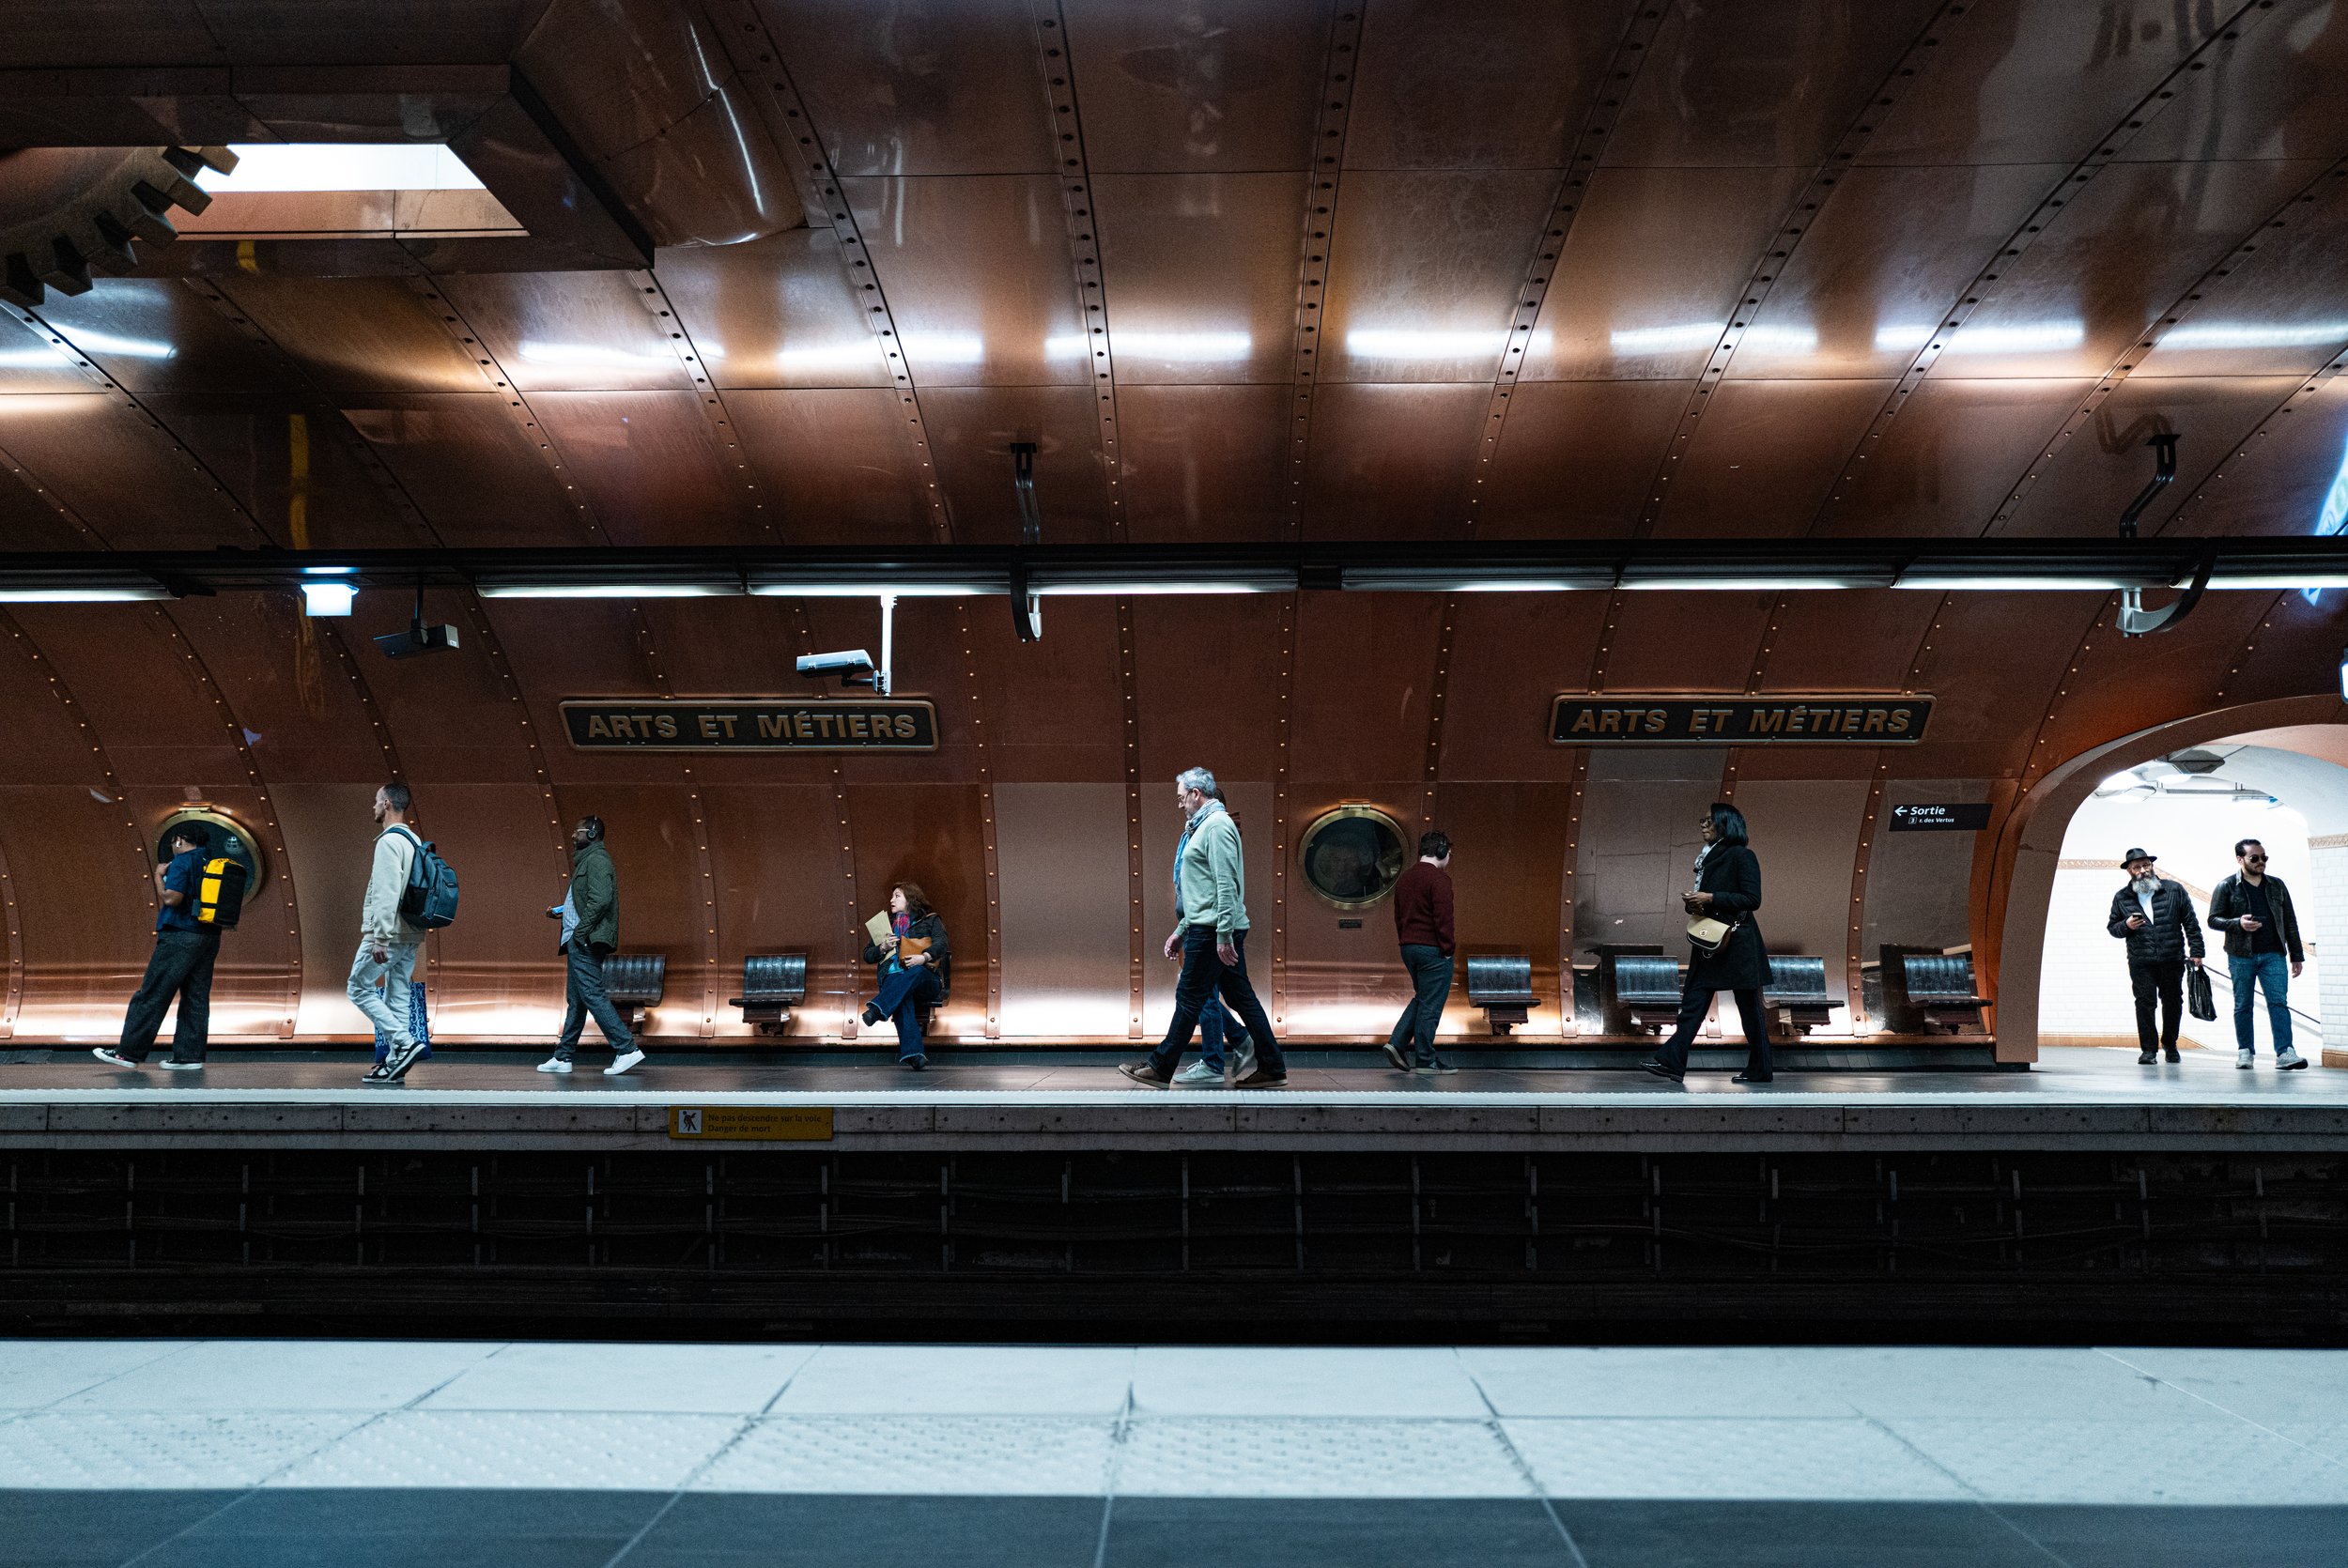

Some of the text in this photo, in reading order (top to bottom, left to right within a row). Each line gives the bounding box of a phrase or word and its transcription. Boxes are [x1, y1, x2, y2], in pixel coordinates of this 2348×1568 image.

[1570, 705, 1912, 733] ARTS ET MÉTIERS
[588, 711, 917, 738] ARTS ET MÉTIERS
[1909, 806, 1946, 815] Sortie
[707, 1114, 719, 1122] Ne
[737, 1114, 779, 1122] descendre
[795, 1114, 803, 1122] la
[707, 1125, 736, 1133] Danger
